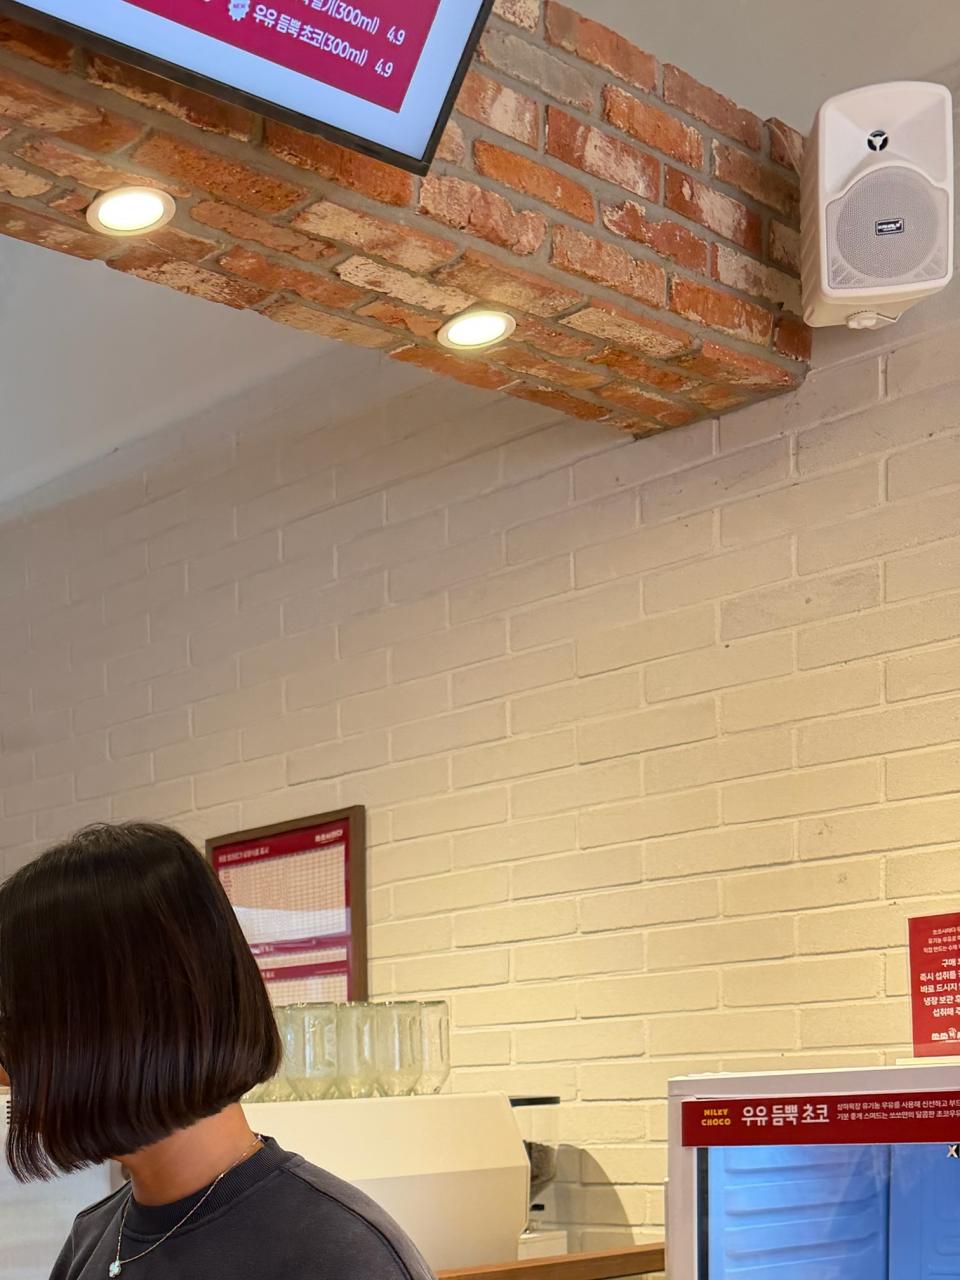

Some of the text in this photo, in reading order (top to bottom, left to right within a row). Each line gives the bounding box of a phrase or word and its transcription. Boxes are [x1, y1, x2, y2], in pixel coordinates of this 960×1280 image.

[387, 25, 406, 45] 4.9
[253, 4, 394, 78] 우유 듬뿍 초코(300ml) 4.9
[920, 972, 934, 982] 즉시
[920, 983, 958, 993] 바로 드시지
[704, 1108, 728, 1116] MILKY
[741, 1103, 830, 1126] 우유 듬뿍 초코
[701, 1118, 731, 1126] CHOCO
